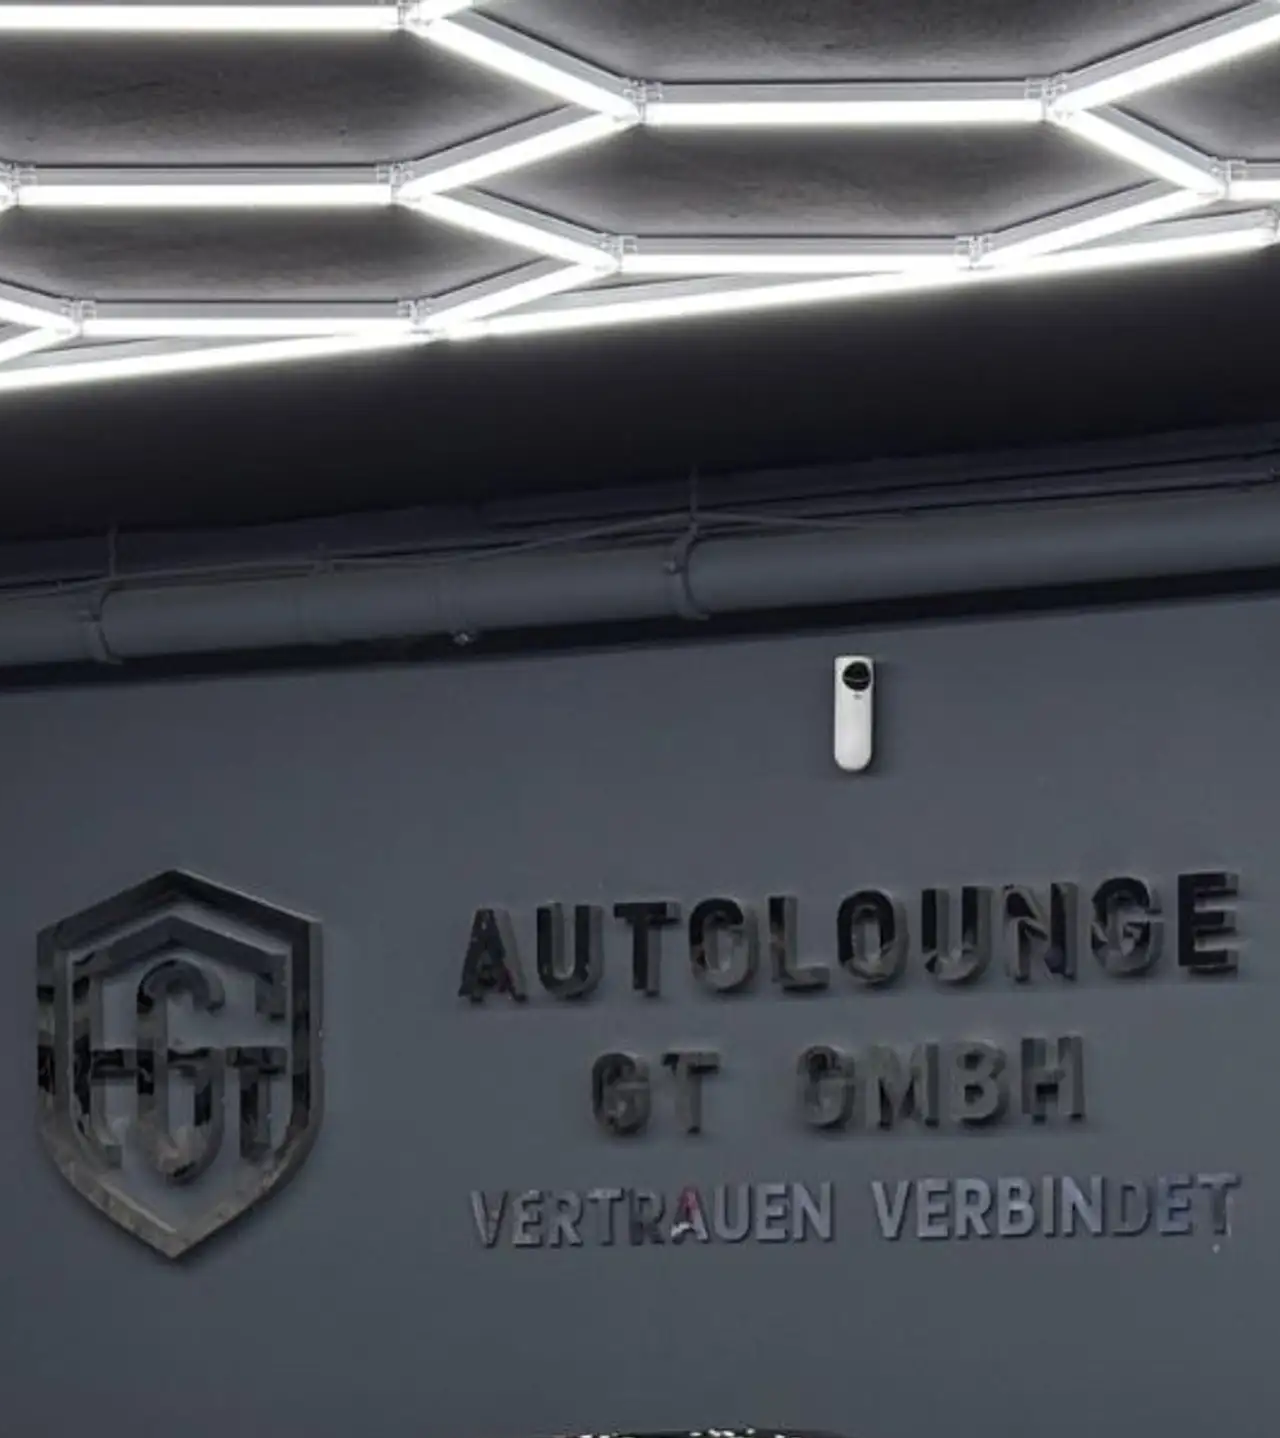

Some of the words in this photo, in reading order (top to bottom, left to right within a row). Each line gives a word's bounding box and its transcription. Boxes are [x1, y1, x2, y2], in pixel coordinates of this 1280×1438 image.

[458, 870, 1242, 1003] AUTOLOUNGE
[589, 1050, 720, 1137] GT
[796, 1034, 1087, 1130] GMBH
[470, 1181, 835, 1250] VERTRAUEN
[871, 1173, 1242, 1243] VERBINDET
